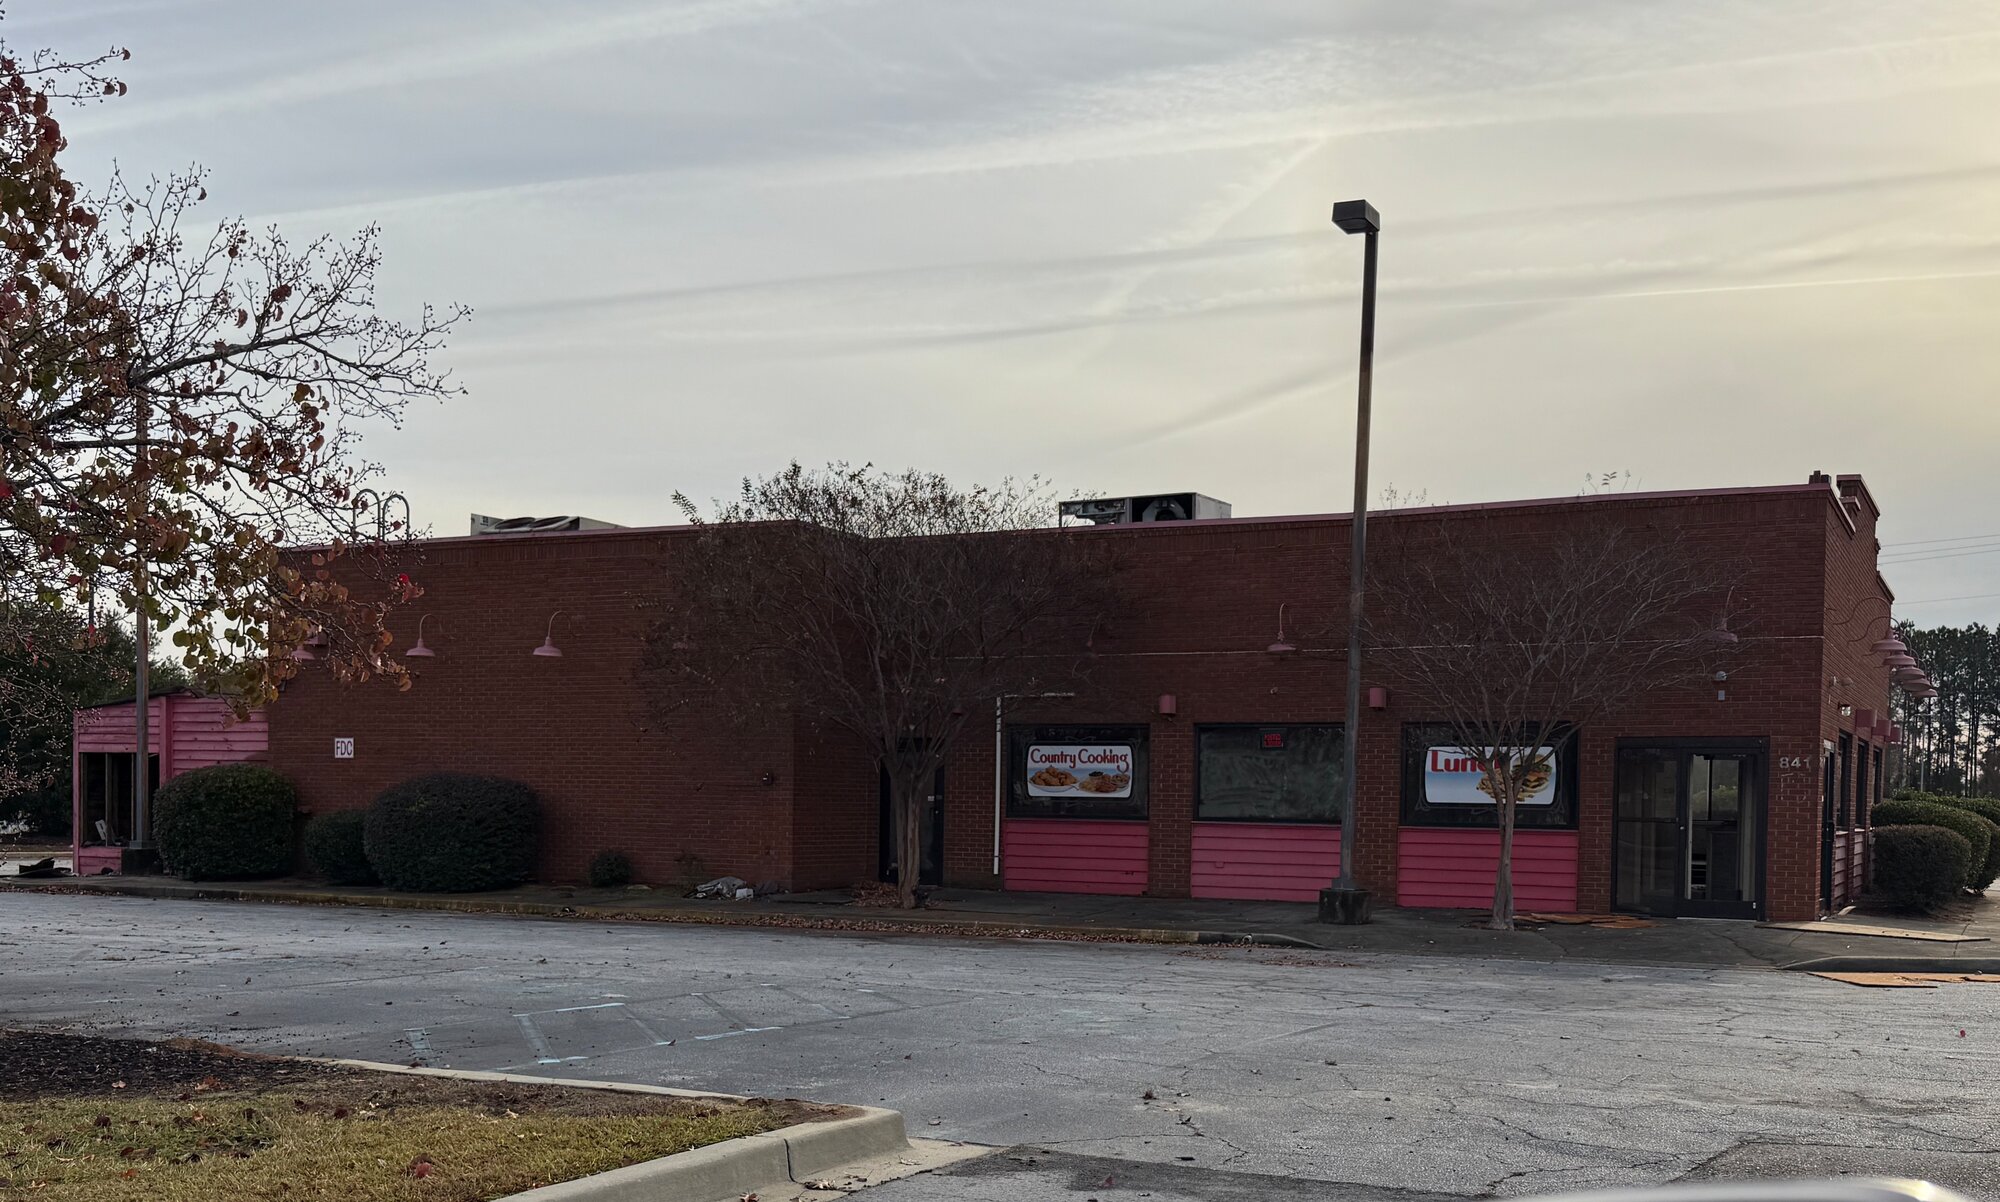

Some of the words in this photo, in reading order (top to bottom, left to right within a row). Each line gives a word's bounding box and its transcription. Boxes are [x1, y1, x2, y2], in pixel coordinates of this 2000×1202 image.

[336, 740, 353, 756] FDC
[1030, 748, 1076, 768] Country
[1078, 748, 1130, 774] Cooking
[1779, 756, 1810, 769] 841
